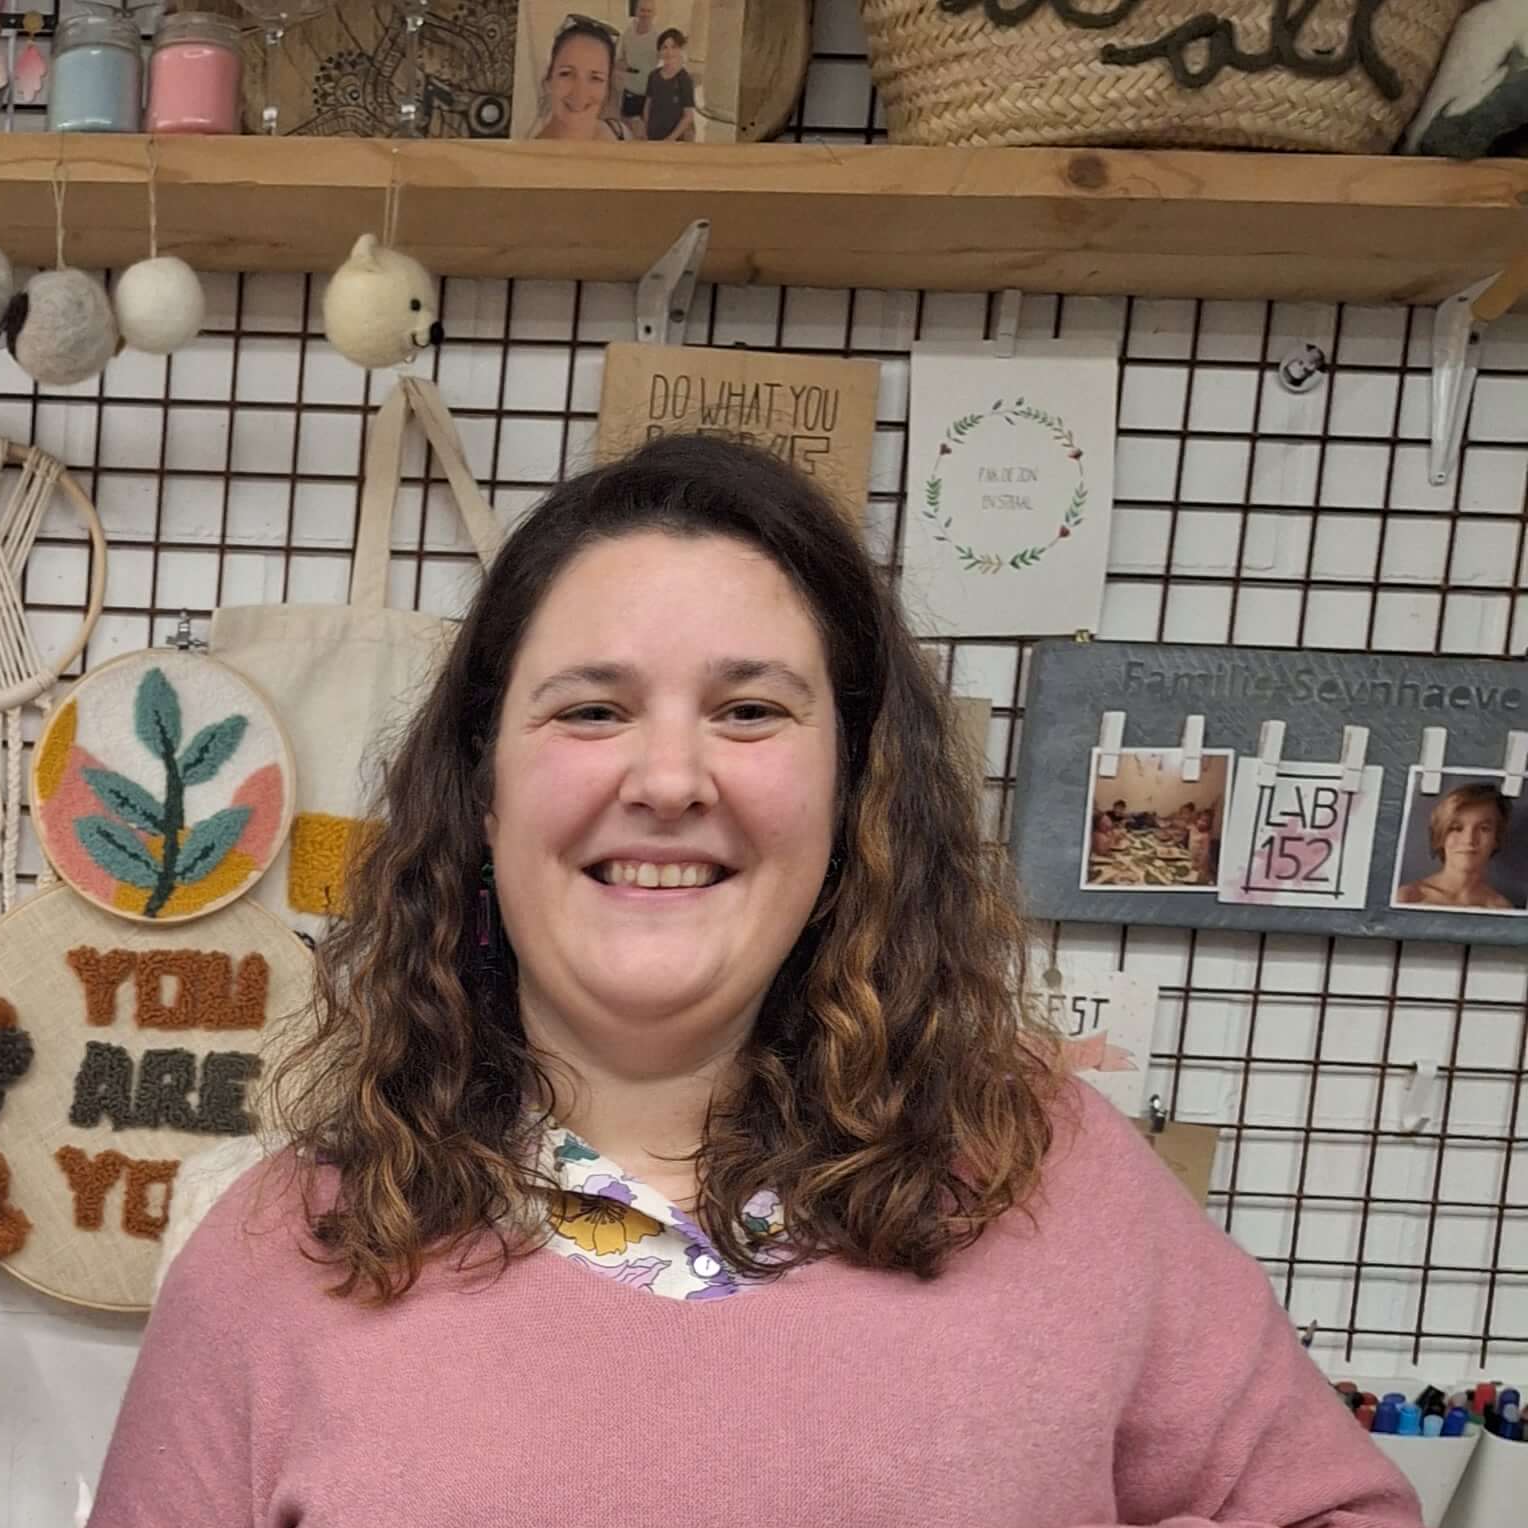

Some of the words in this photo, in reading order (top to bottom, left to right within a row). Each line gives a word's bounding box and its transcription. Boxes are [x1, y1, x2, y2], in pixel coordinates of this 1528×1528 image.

[649, 374, 691, 420] DO
[700, 376, 782, 428] WHAT
[789, 385, 840, 432] YOU
[1122, 660, 1272, 698] Familie
[1263, 784, 1339, 830] LAB
[1259, 835, 1335, 882] 152
[67, 945, 270, 1031] YOU
[69, 1041, 263, 1137] ARE
[55, 1145, 180, 1240] YO
